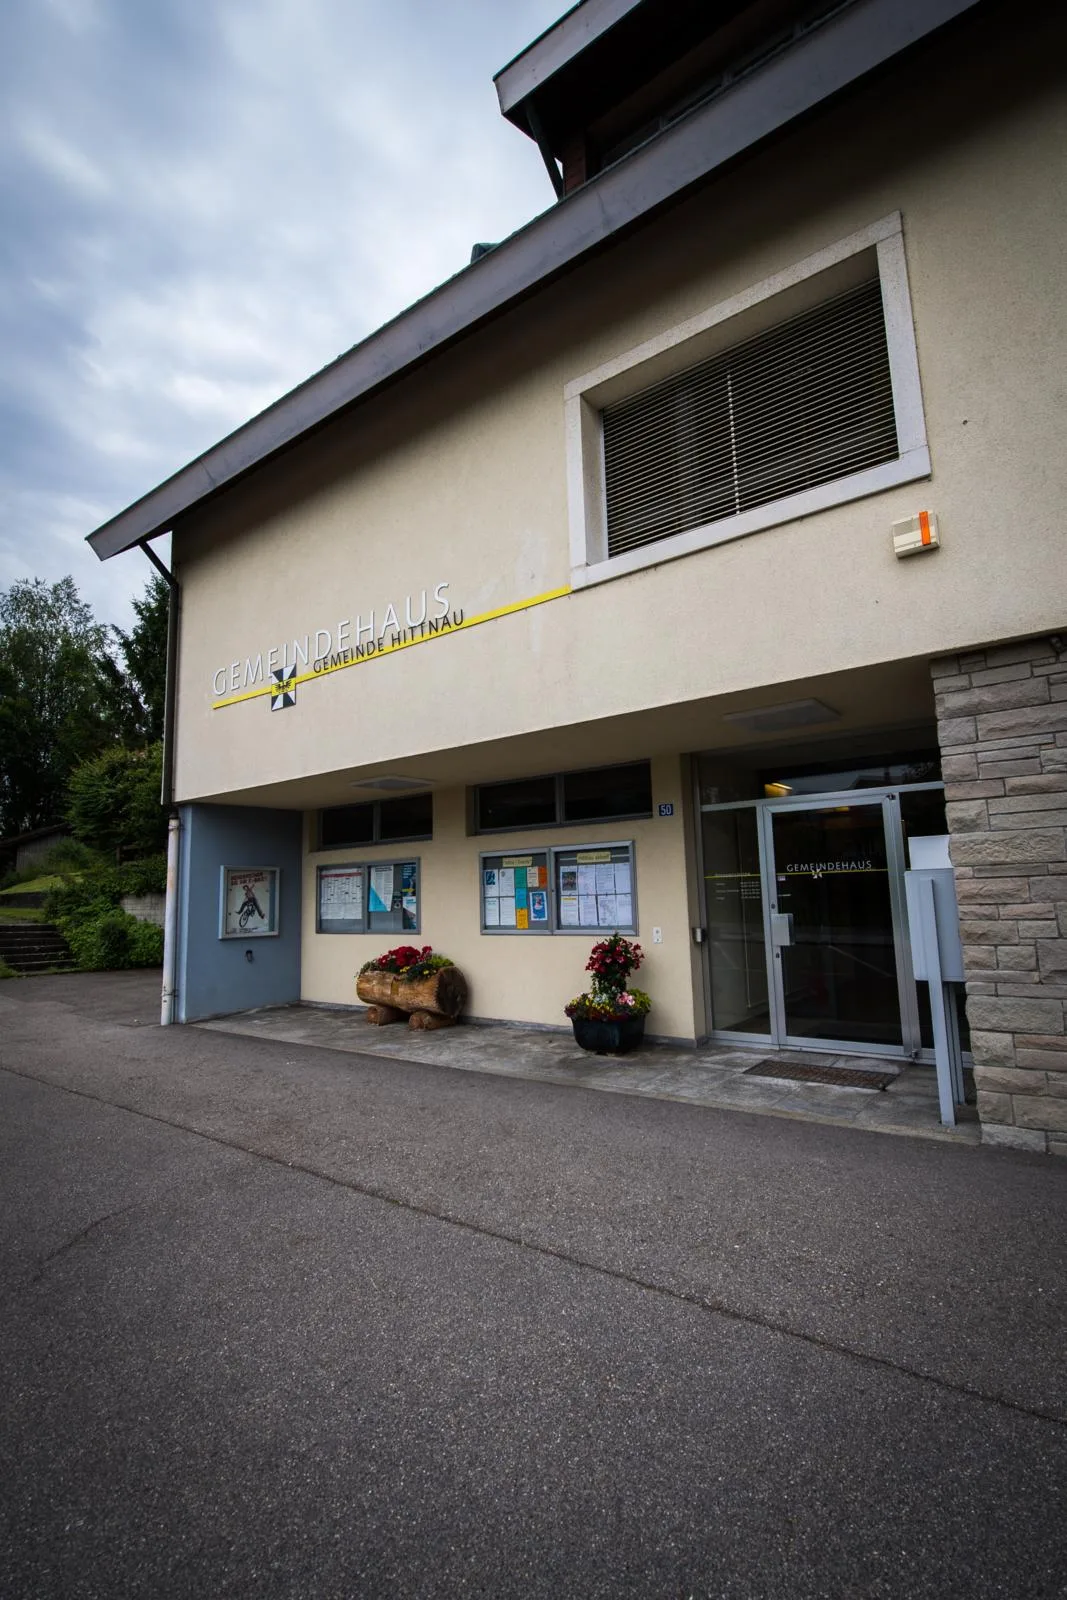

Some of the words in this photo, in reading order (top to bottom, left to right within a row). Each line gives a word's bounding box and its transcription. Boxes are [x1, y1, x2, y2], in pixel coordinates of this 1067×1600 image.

[213, 582, 450, 696] GEMEINDEHAUS
[312, 636, 384, 674] GEMEINDE
[391, 609, 465, 649] HITTNAU
[660, 804, 672, 815] 50
[786, 860, 872, 872] GEMEINDEHAUS
